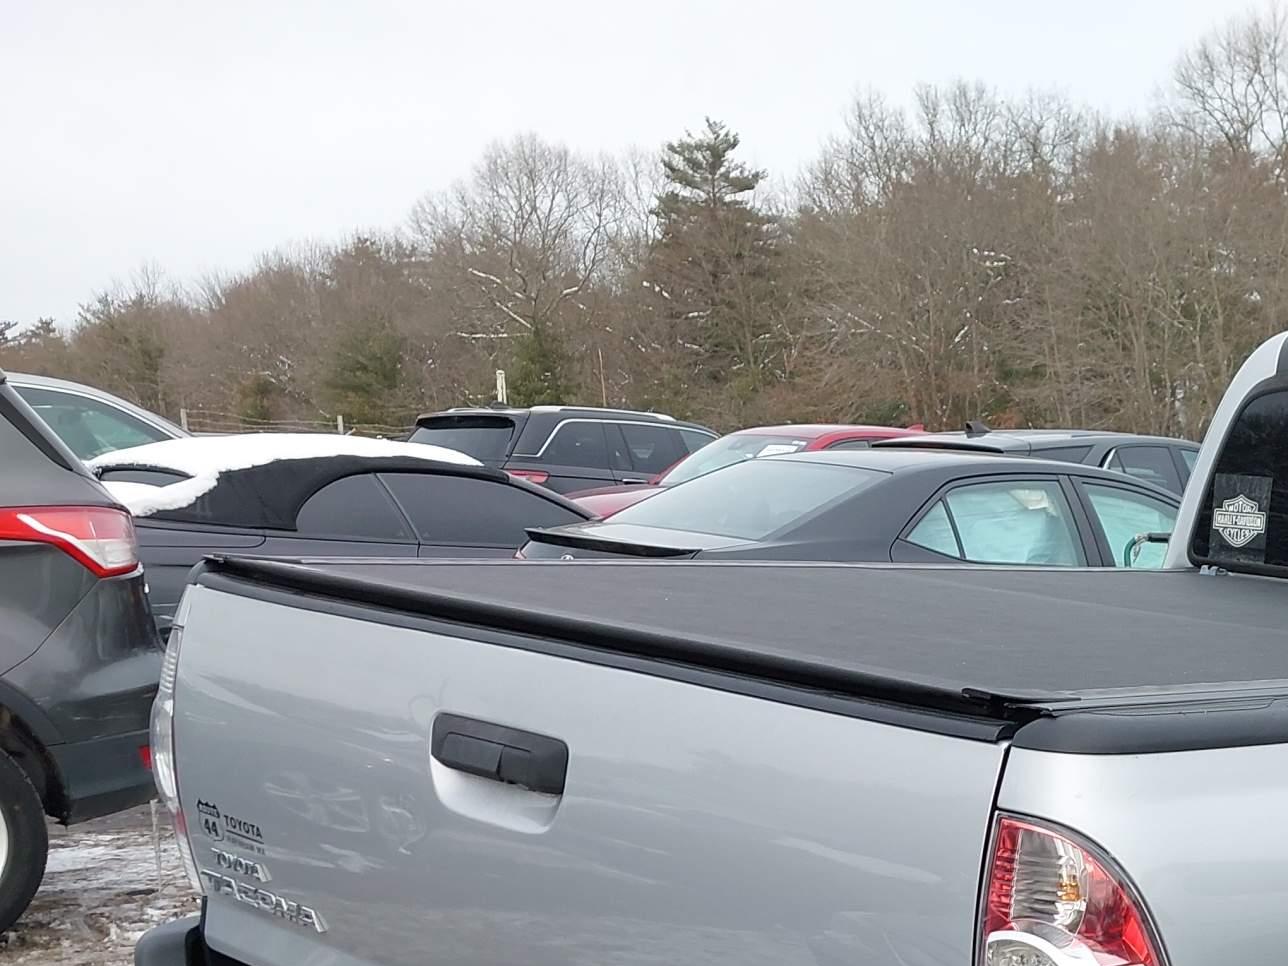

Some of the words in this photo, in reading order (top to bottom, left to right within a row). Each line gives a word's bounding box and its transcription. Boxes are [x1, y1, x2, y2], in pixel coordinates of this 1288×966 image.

[1228, 501, 1253, 512] MOTOR
[1226, 528, 1250, 541] CYCLES
[204, 818, 219, 837] 44
[223, 814, 263, 839] TOYOTA
[201, 868, 329, 933] TACOMA
